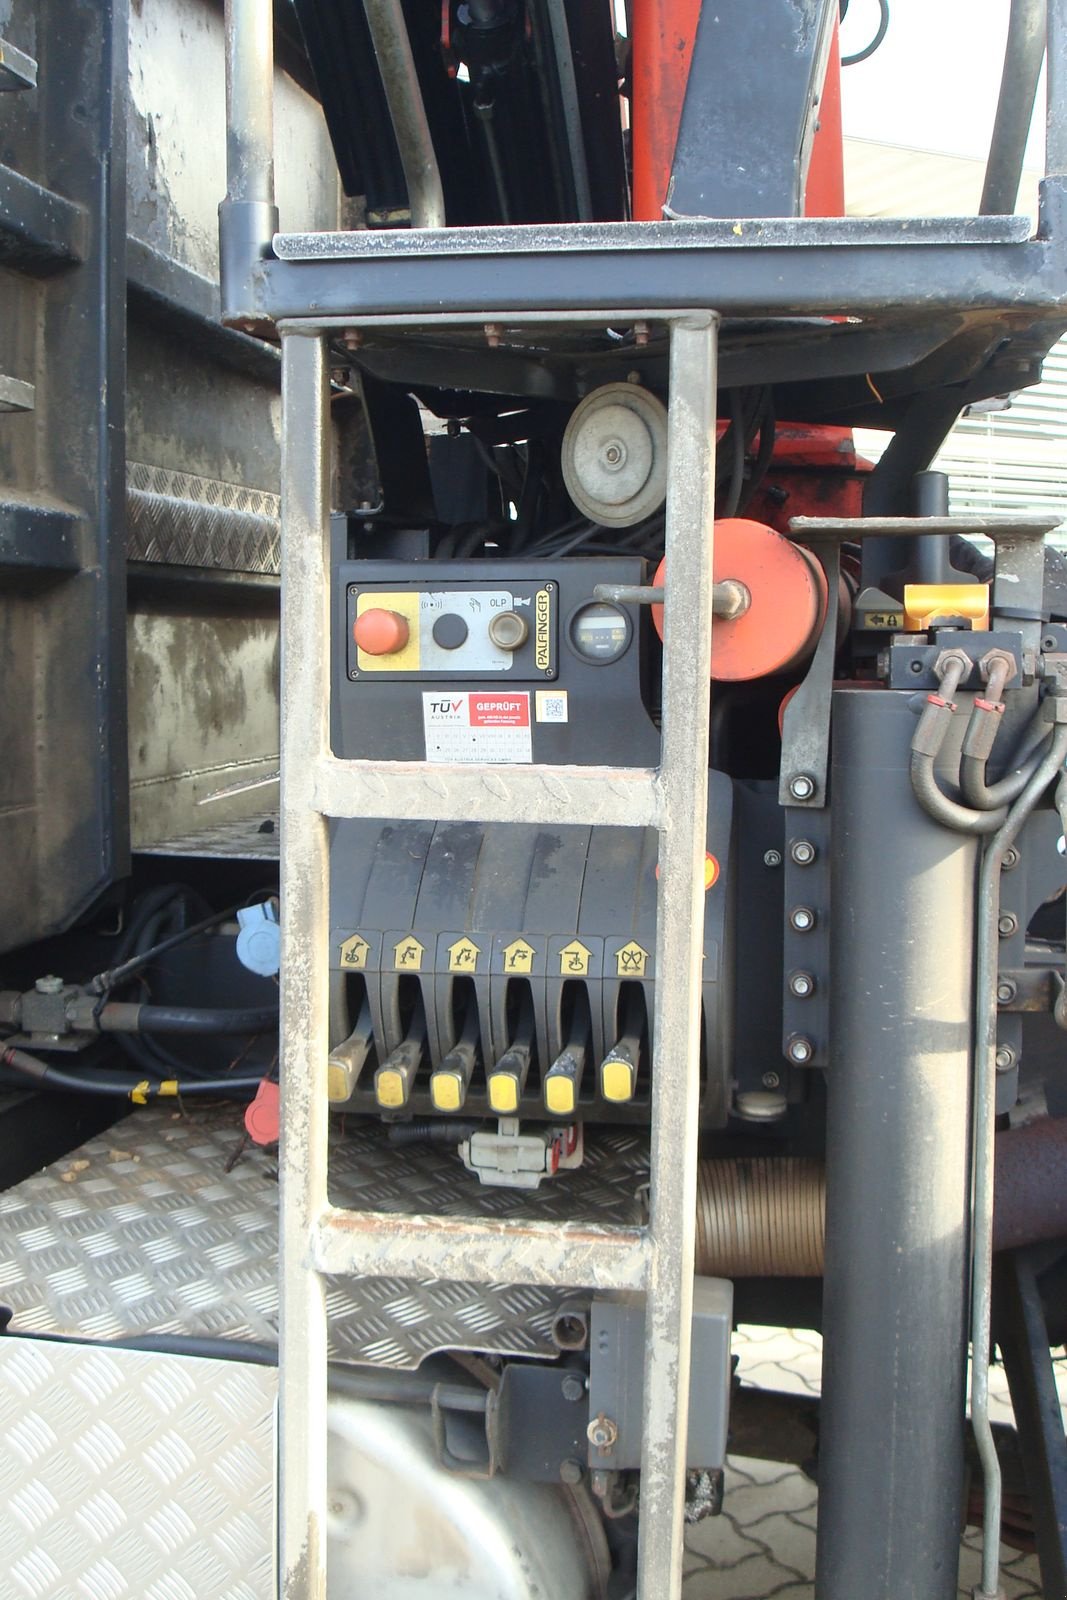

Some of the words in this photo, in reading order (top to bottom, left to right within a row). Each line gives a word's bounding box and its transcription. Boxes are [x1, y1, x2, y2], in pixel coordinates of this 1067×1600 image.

[490, 598, 507, 607] OLP
[537, 594, 548, 665] PALFINGER
[476, 701, 521, 711] GEPRÜFT
